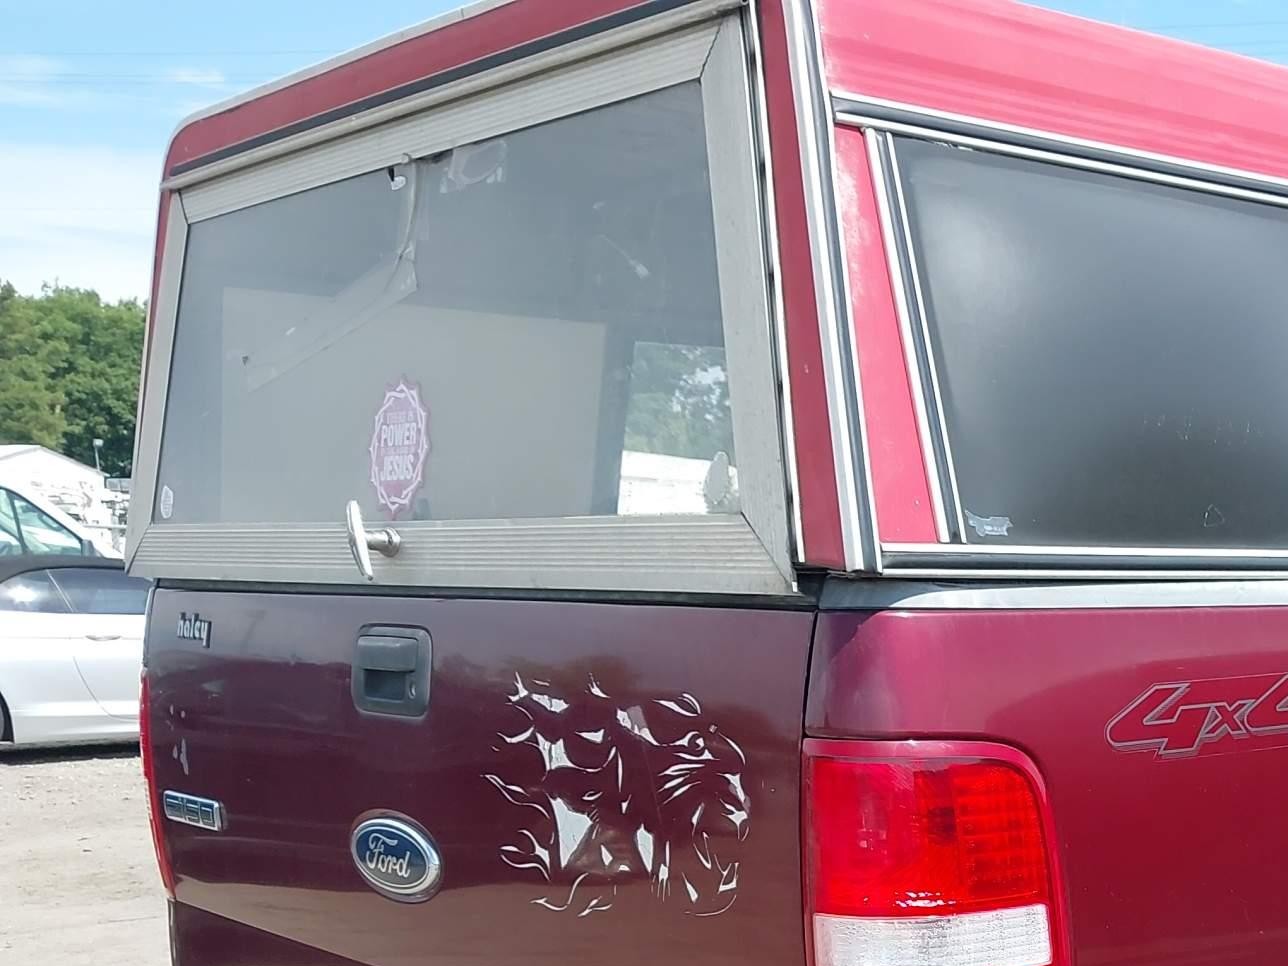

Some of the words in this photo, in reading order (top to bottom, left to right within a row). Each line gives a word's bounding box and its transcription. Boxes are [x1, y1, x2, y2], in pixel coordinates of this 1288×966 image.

[380, 422, 417, 447] POWER
[380, 454, 415, 481] JESUS
[366, 832, 411, 878] Ford
